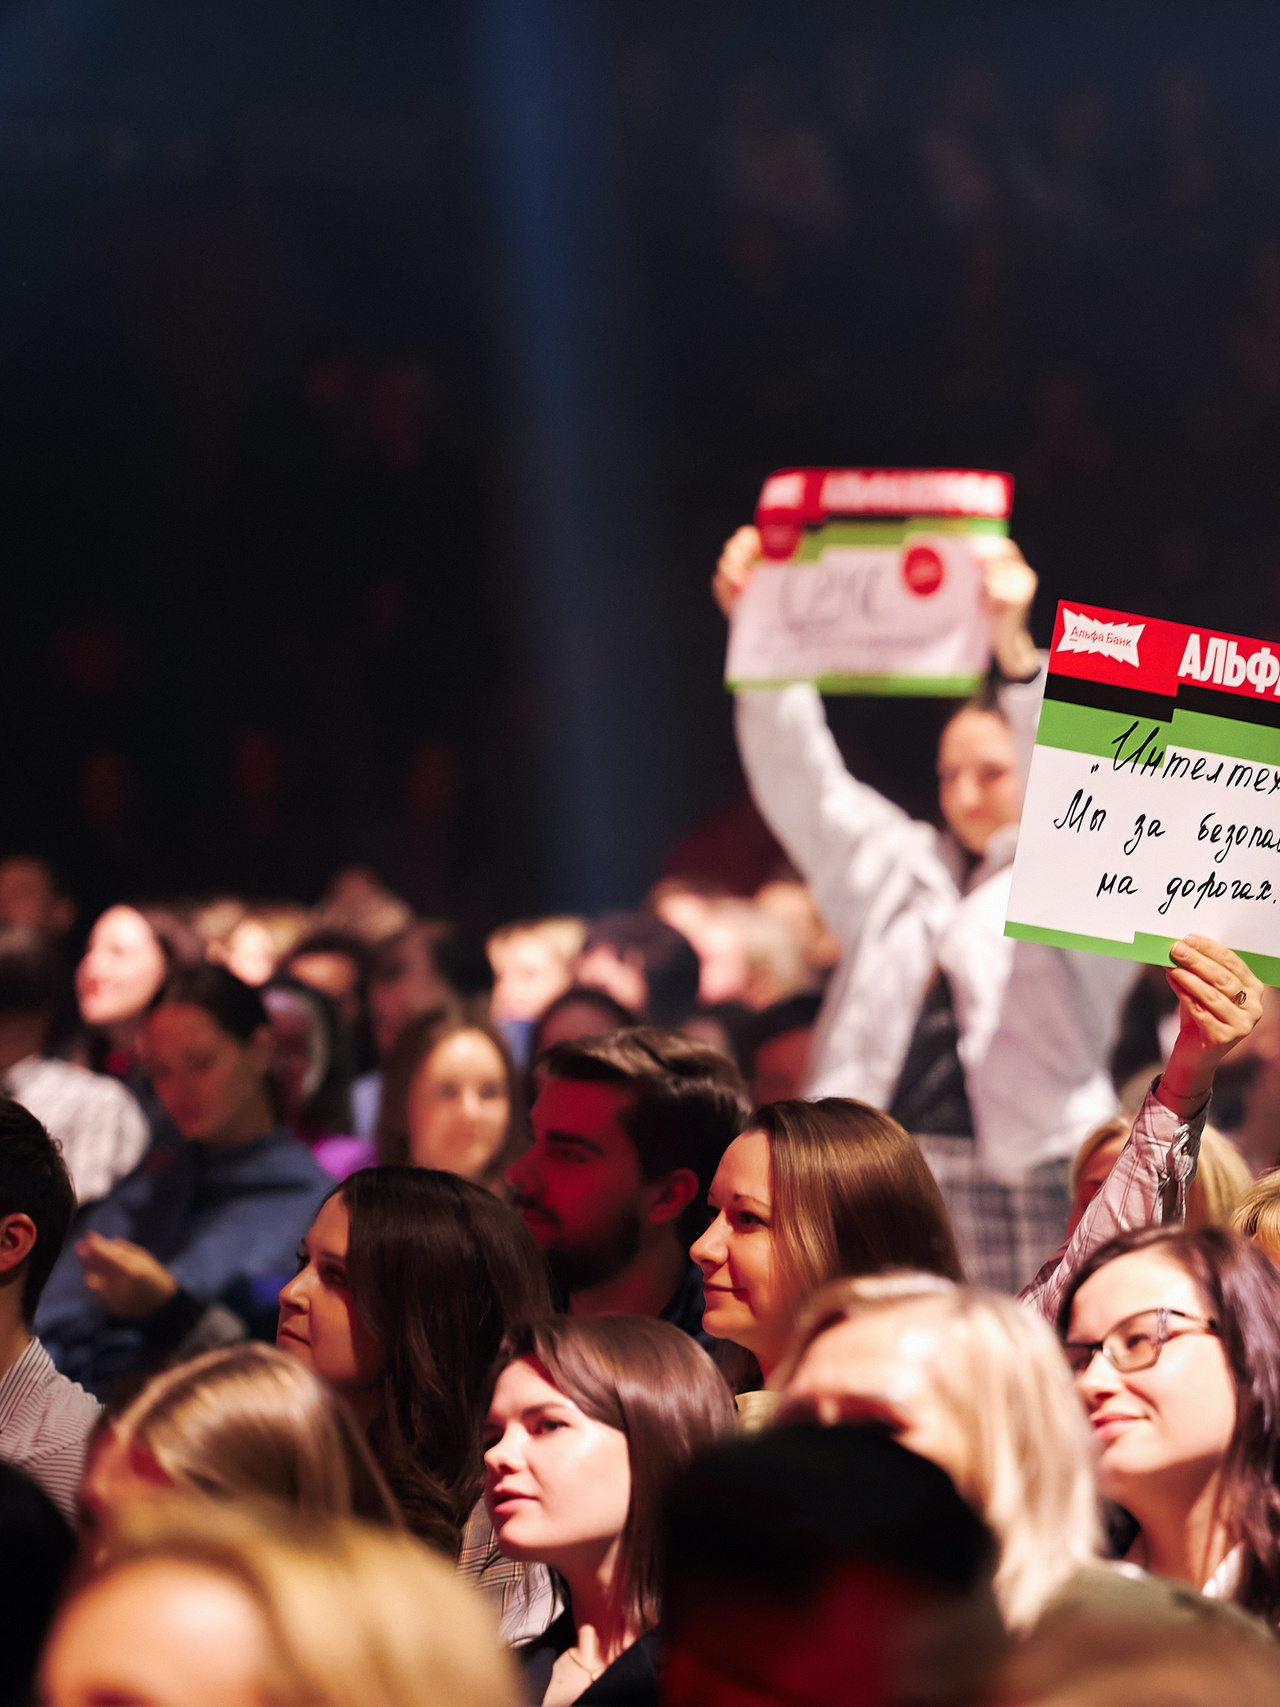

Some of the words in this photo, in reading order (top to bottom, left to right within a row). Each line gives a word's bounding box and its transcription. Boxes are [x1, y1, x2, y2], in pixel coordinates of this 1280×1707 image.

[1069, 625, 1104, 643] Альфа
[1106, 632, 1131, 648] Банк
[1053, 788, 1107, 833] Мы
[1123, 813, 1166, 856] за
[1096, 872, 1139, 897] на
